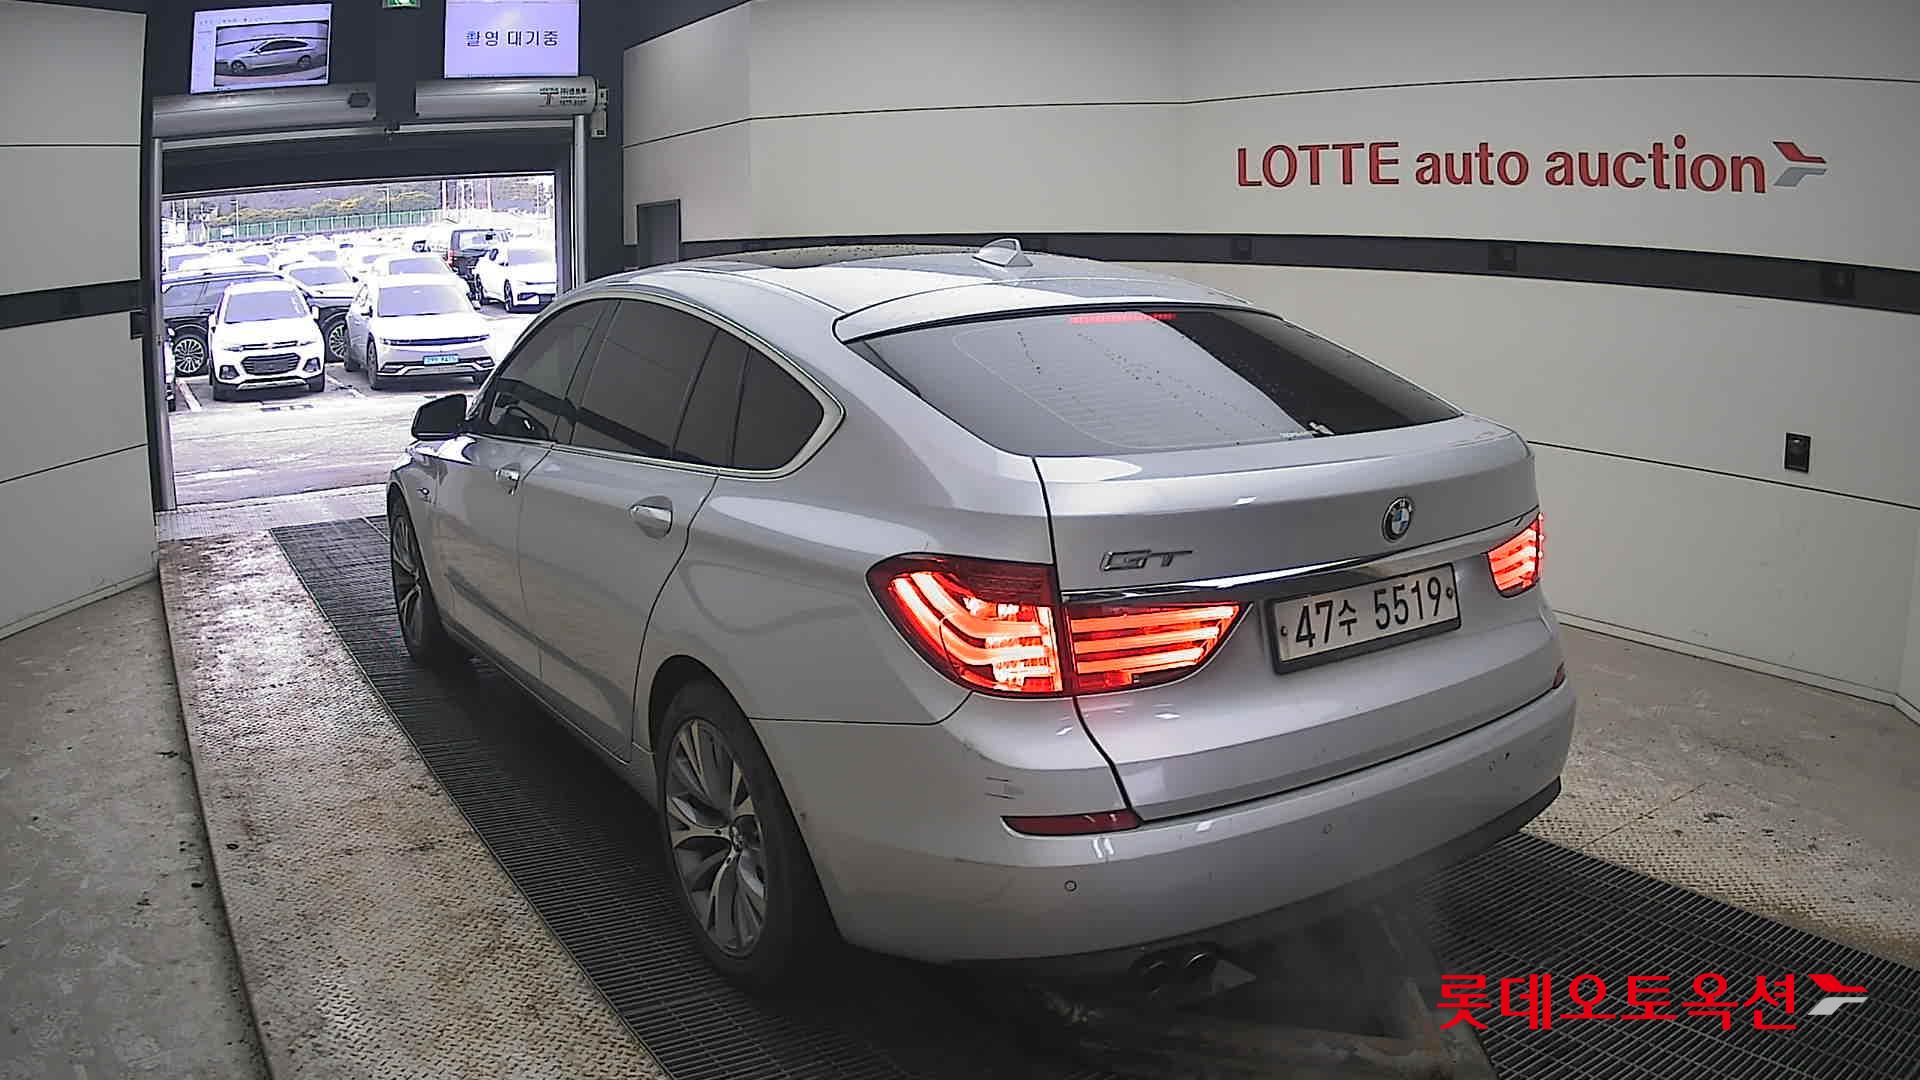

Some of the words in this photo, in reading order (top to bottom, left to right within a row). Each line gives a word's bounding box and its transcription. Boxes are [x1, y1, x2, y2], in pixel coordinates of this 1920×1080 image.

[507, 31, 559, 47] 대기중
[1237, 141, 1400, 188] LOTTE
[1415, 142, 1529, 187] auto
[1545, 134, 1767, 194] auction
[1100, 549, 1193, 572] GT
[1295, 599, 1358, 648] 47수
[1373, 576, 1442, 631] 5519
